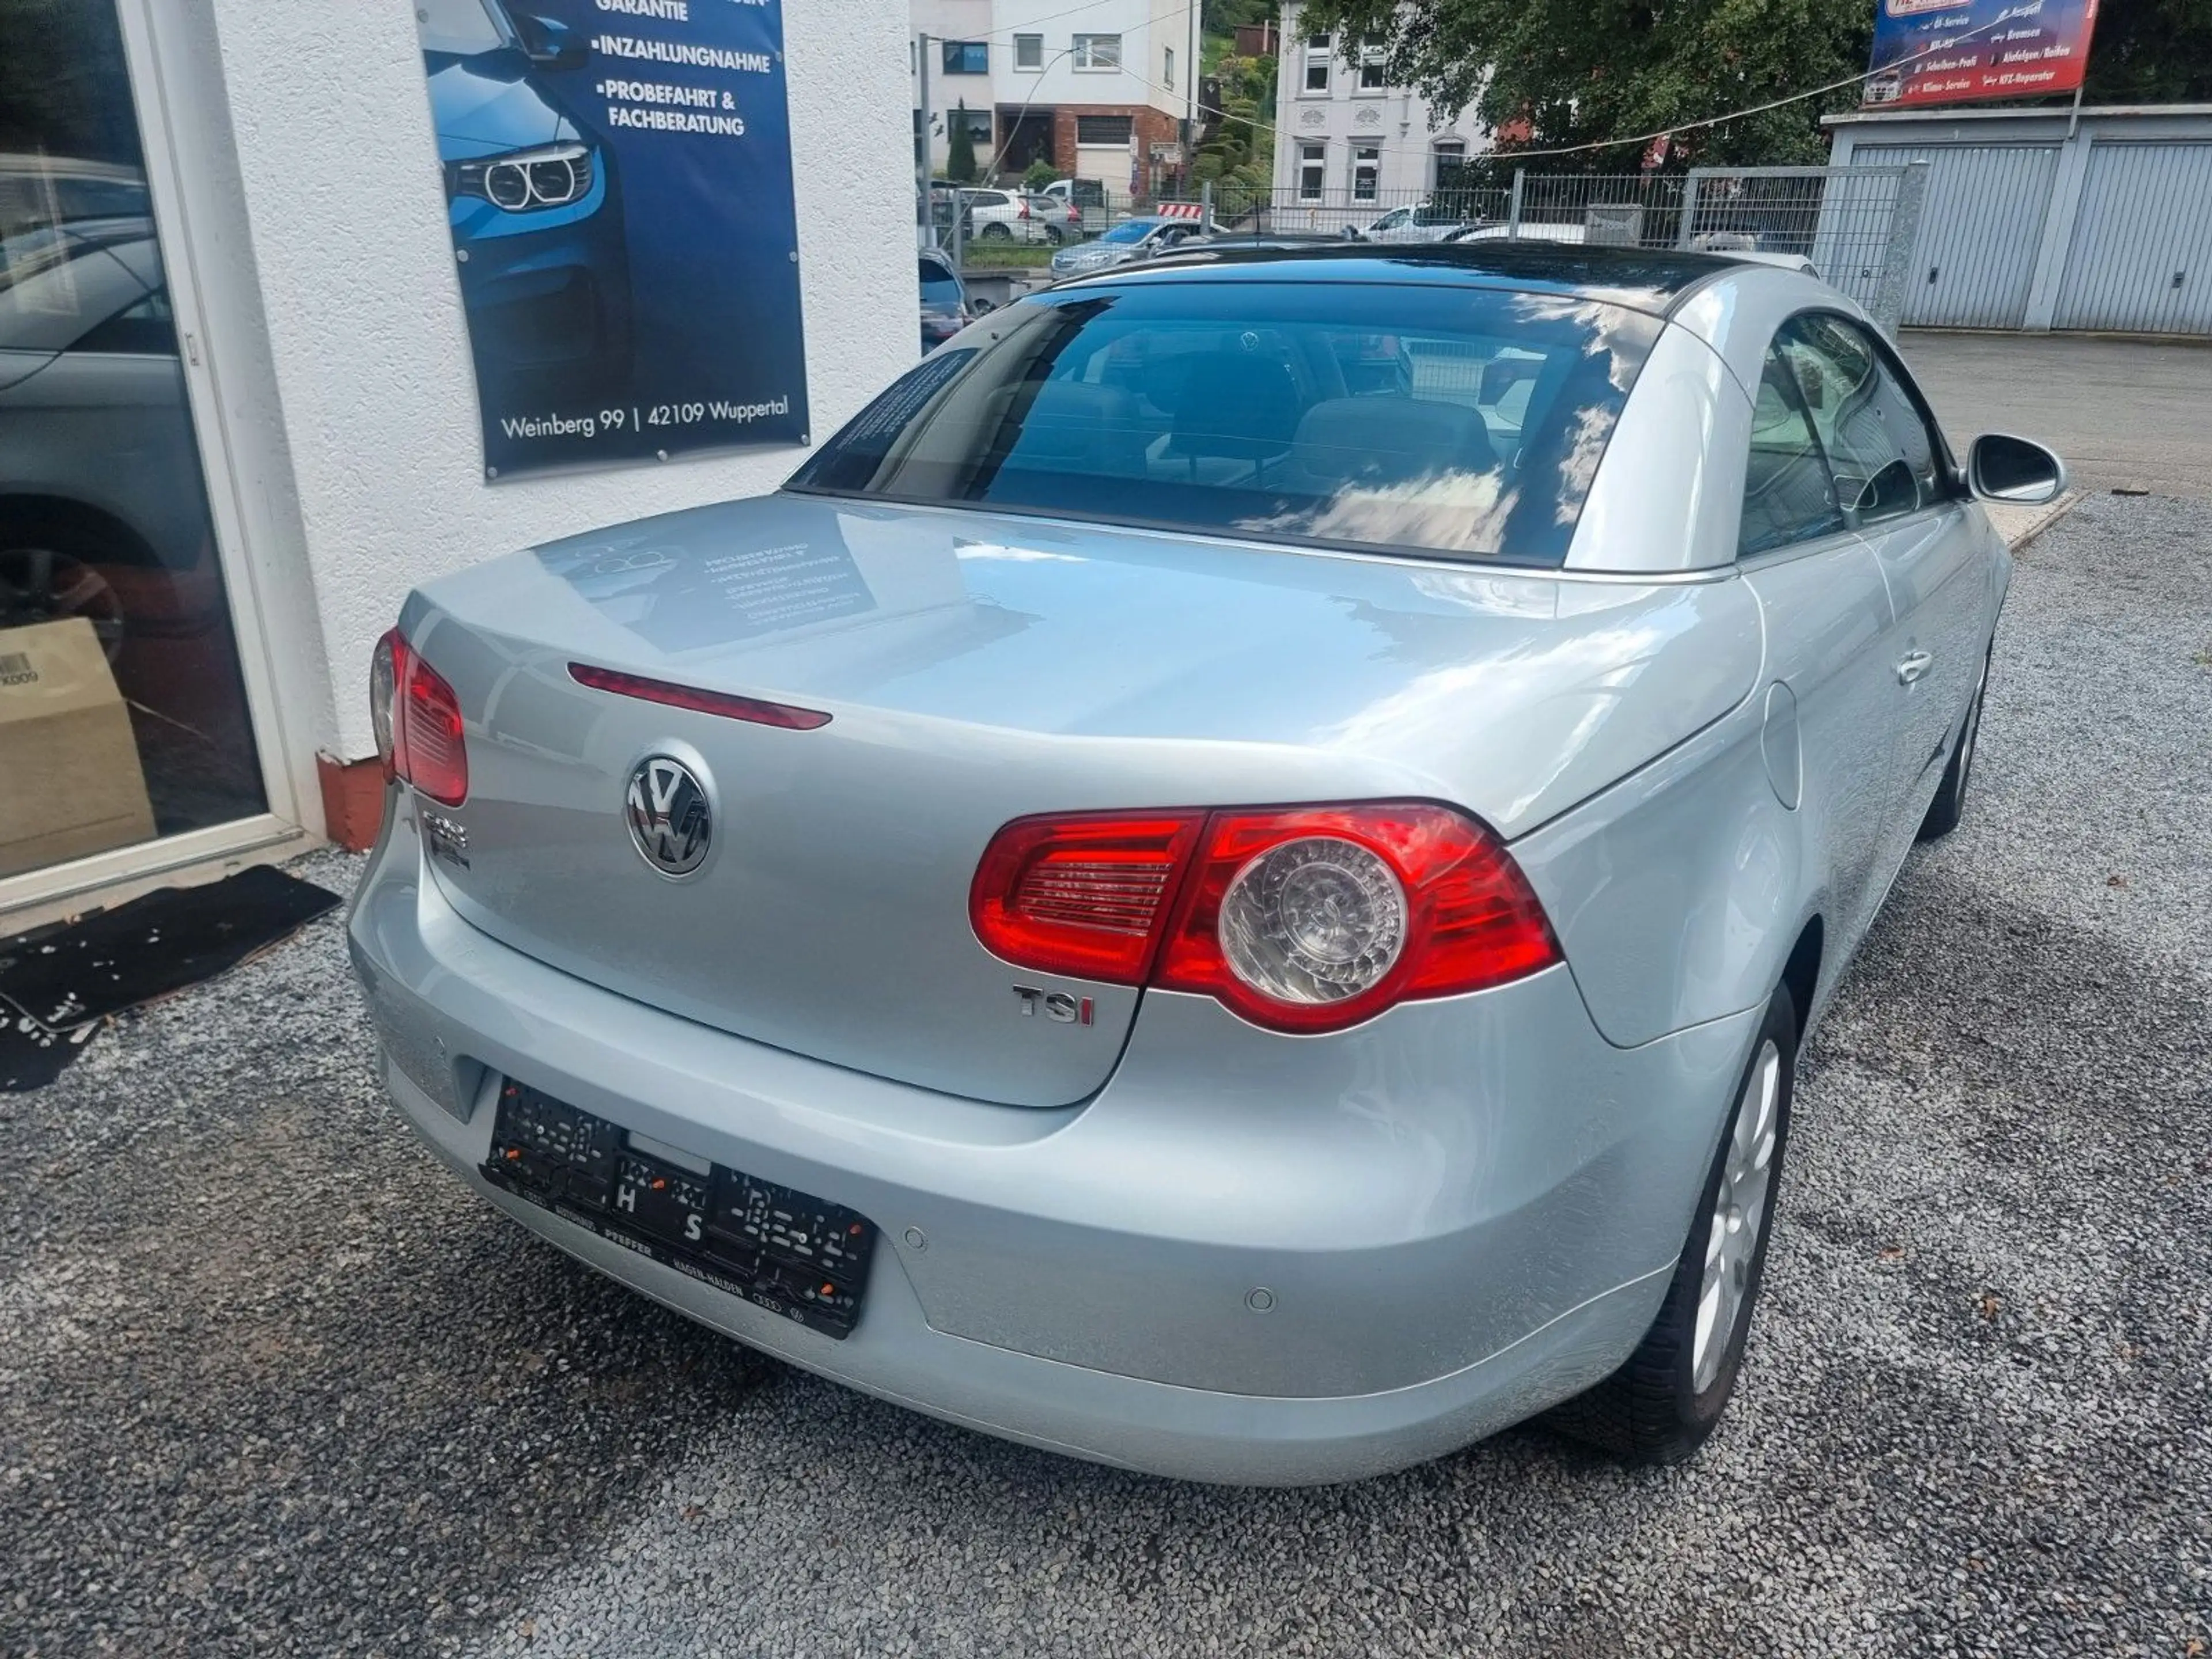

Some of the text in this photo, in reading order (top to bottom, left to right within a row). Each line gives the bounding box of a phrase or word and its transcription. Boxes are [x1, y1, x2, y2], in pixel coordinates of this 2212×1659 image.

[595, 0, 688, 21] GARANTIE
[600, 35, 771, 73] INZAHLUNGNAHME
[605, 79, 736, 110] PROBEFAHRT &
[608, 107, 745, 137] FACHBERATUNG
[500, 412, 595, 439] Weinberg
[599, 408, 625, 430] 99
[647, 402, 704, 426] 42109
[708, 394, 789, 424] Wuppertal
[1012, 983, 1094, 1027] TSI
[616, 1183, 636, 1213] H
[604, 1228, 653, 1257] PFEFFER
[684, 1214, 703, 1241] S
